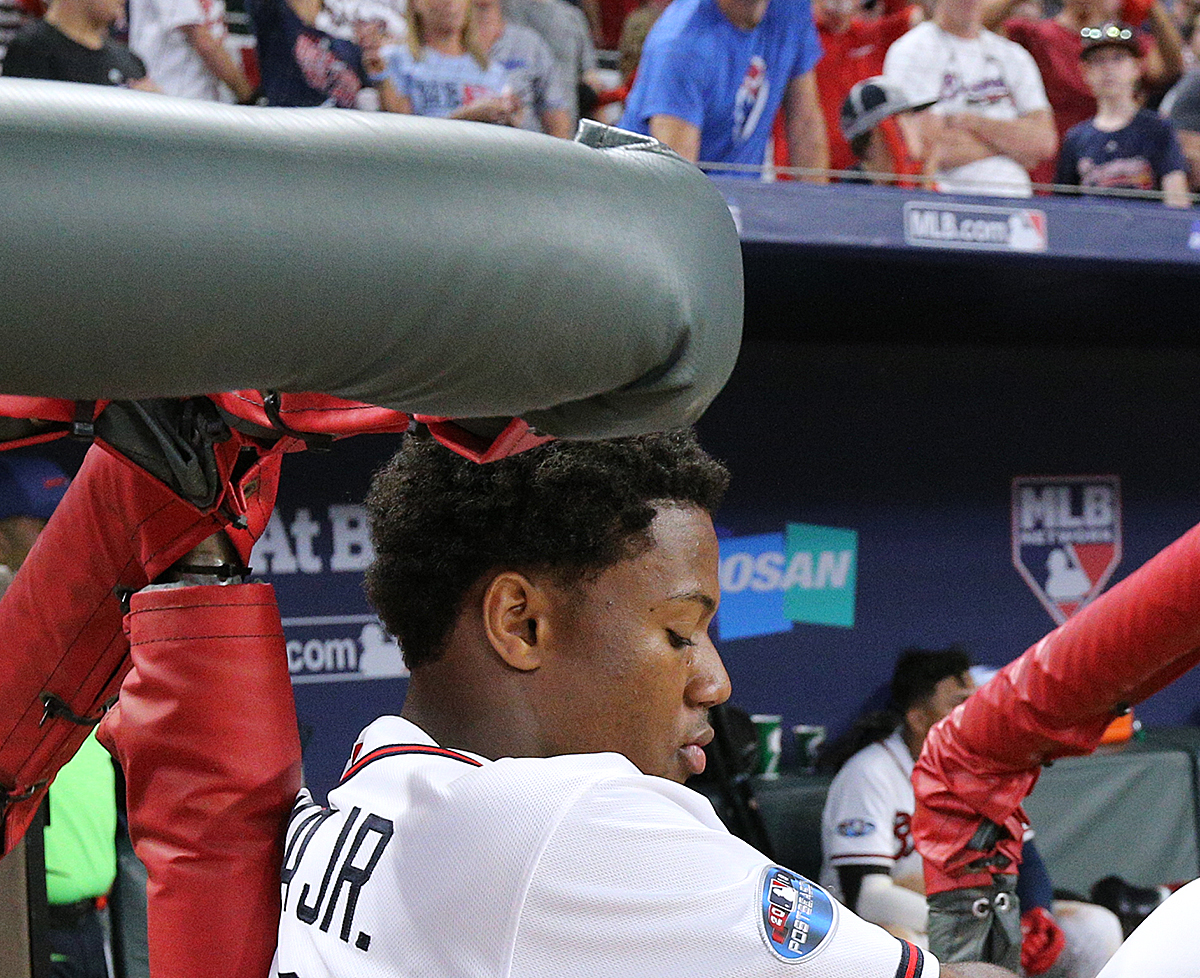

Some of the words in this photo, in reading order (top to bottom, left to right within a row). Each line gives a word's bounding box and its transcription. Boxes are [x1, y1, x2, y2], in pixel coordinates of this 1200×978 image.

[910, 209, 1009, 242] MLB.com
[1020, 485, 1113, 528] MLB
[717, 549, 853, 594] OSAN
[296, 805, 395, 953] JR.
[769, 904, 787, 928] 20
